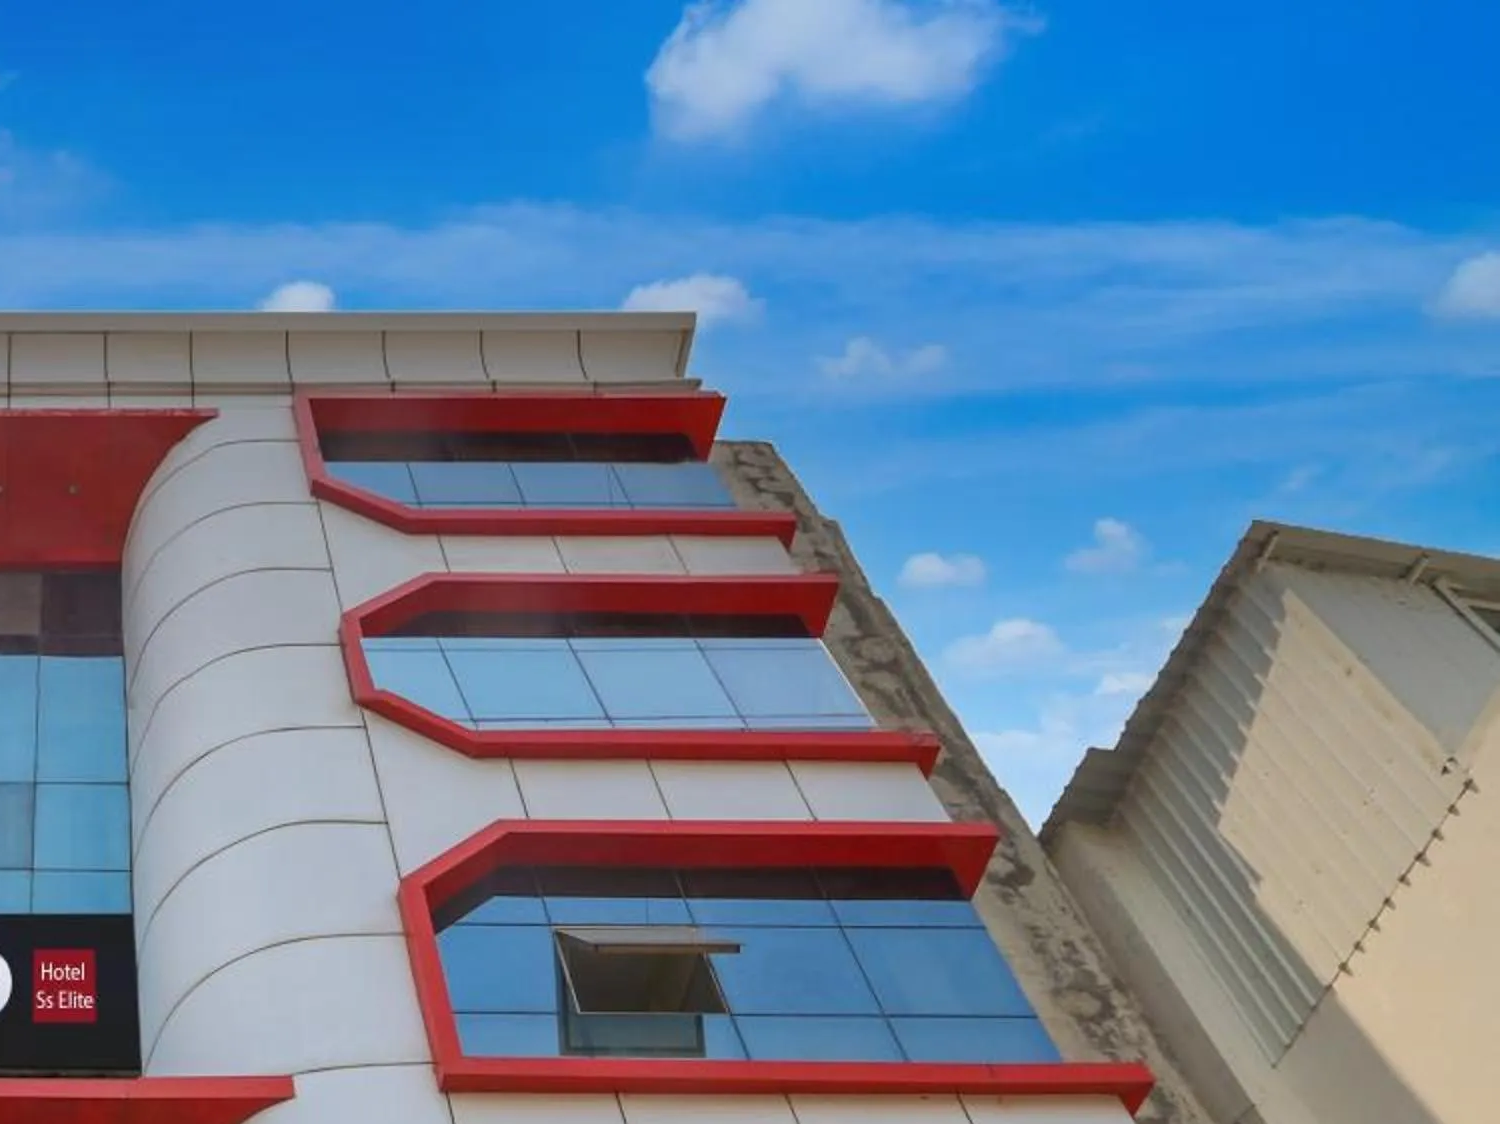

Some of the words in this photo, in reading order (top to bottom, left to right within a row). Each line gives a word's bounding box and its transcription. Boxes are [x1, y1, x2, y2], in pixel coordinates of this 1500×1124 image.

[40, 962, 85, 982] Hotel
[36, 991, 54, 1009] Ss
[58, 990, 94, 1009] Elite
